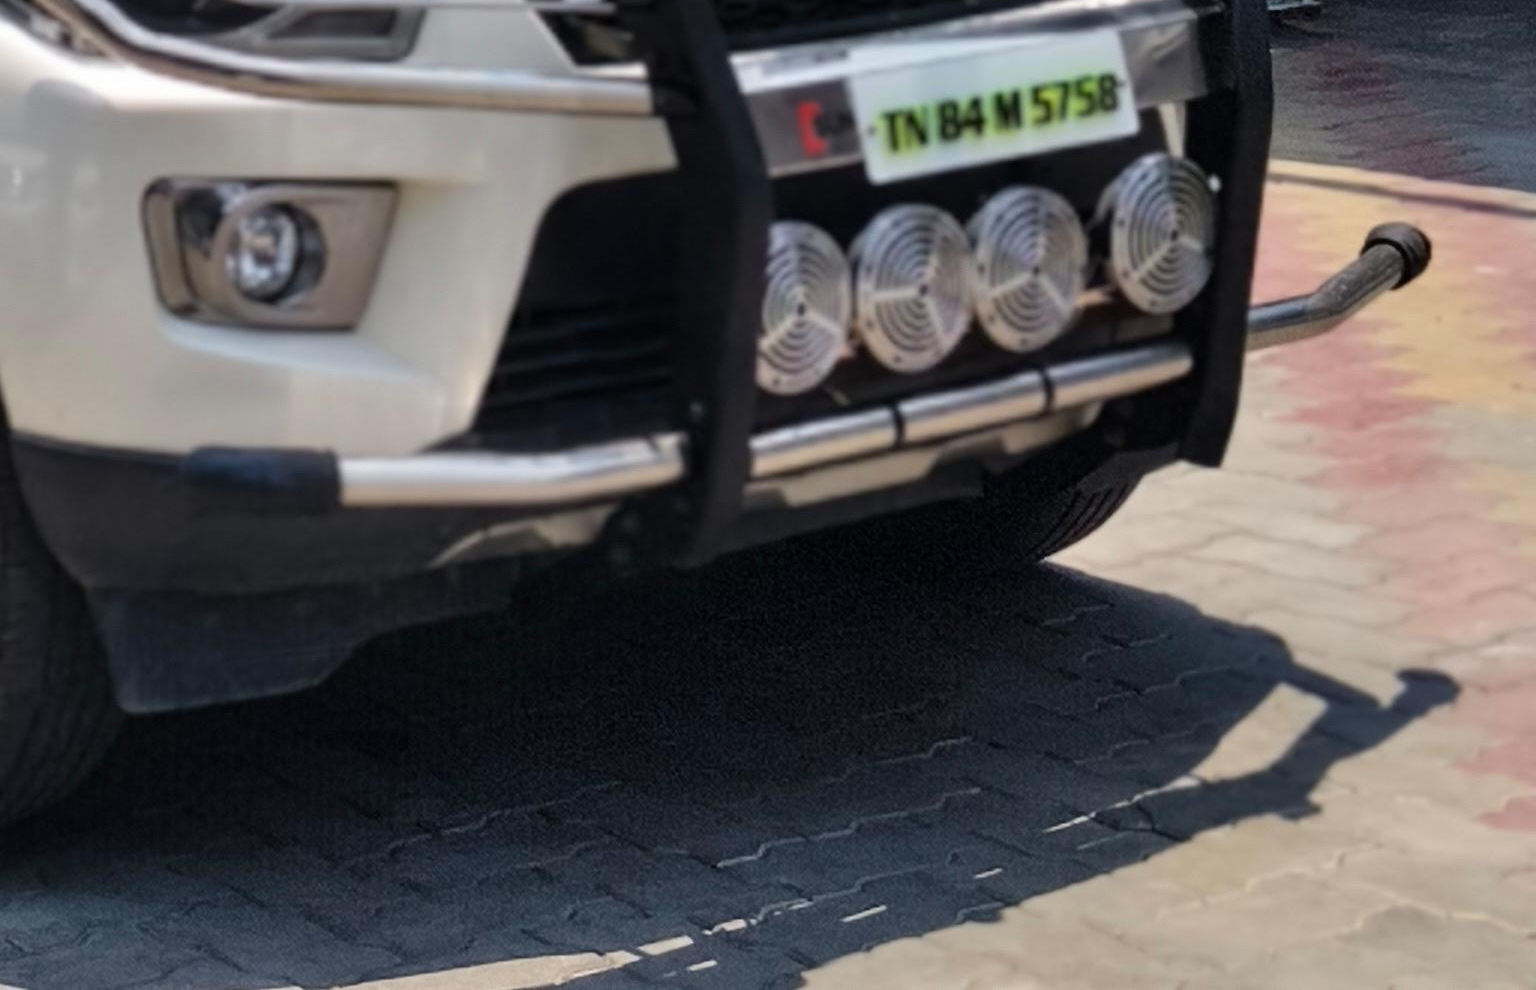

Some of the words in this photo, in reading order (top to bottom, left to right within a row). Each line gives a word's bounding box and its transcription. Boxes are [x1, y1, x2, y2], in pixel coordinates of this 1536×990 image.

[882, 106, 930, 153] TN
[937, 97, 986, 142] 84
[995, 86, 1023, 131] M
[1030, 73, 1120, 126] 5758
